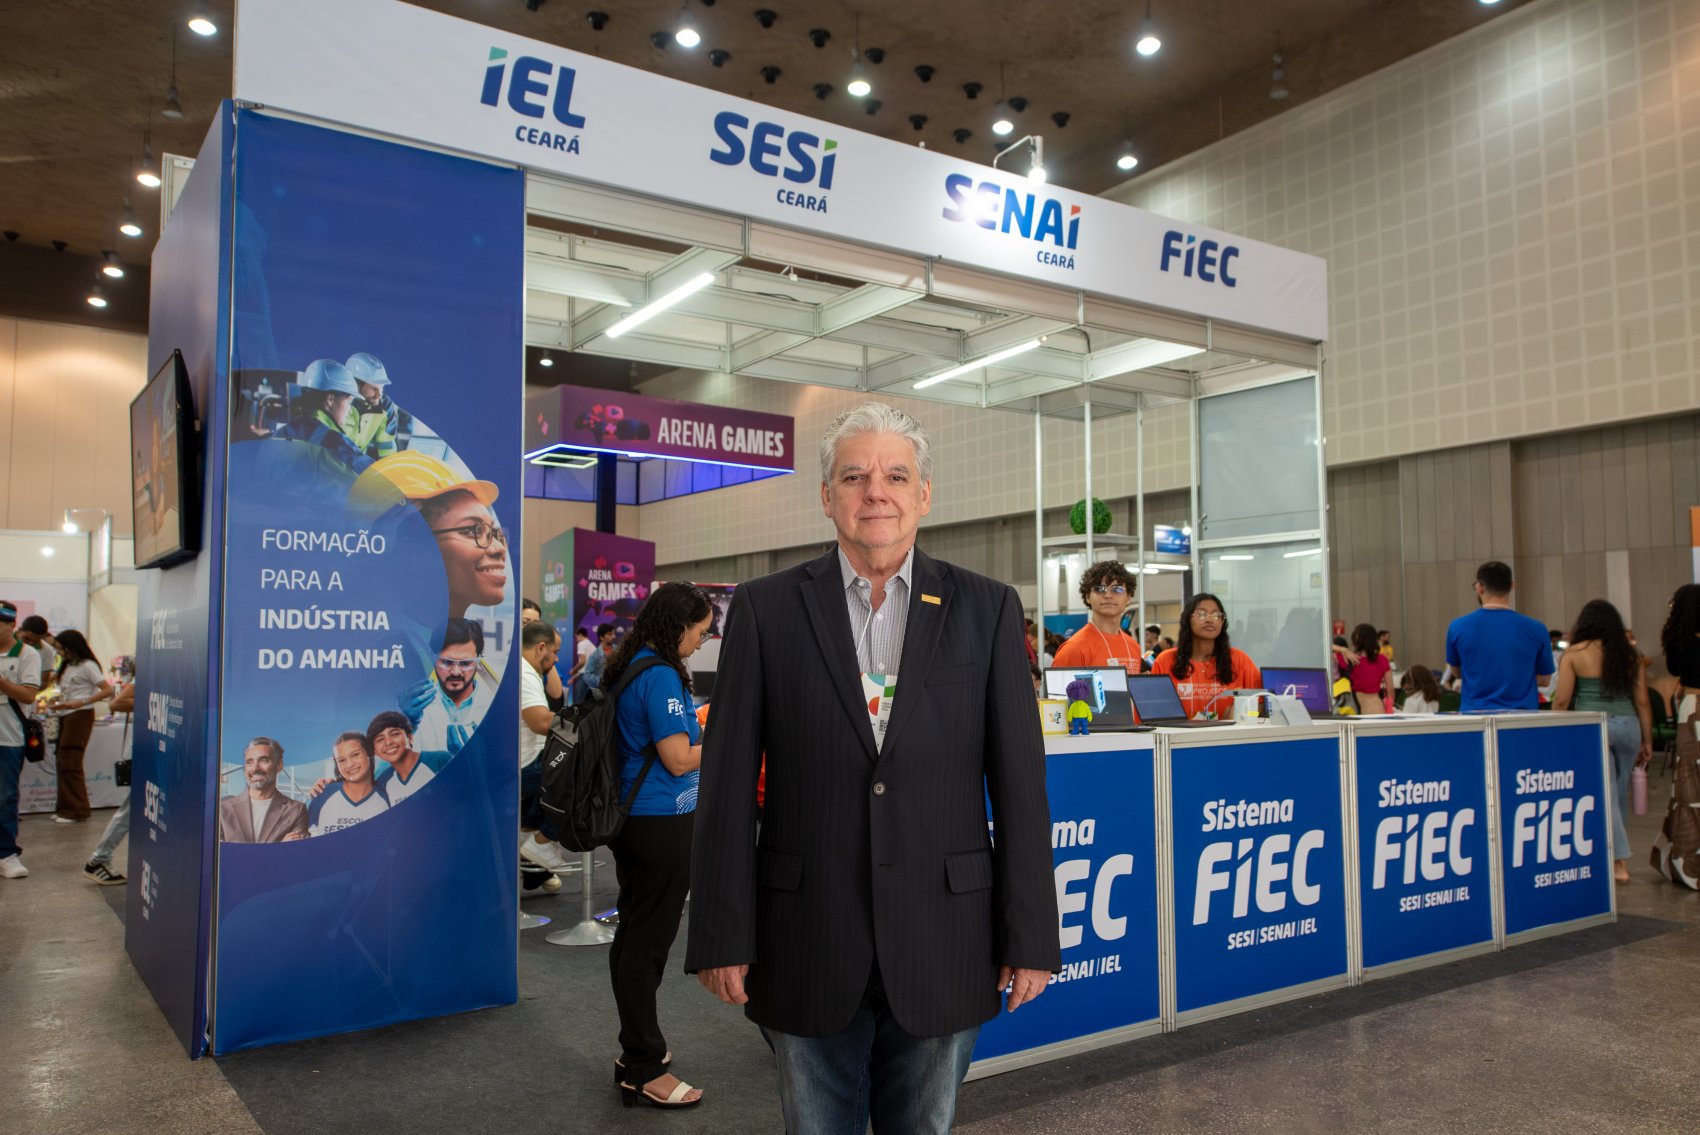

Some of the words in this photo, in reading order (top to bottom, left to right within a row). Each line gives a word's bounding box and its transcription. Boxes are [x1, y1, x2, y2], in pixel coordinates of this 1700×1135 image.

[515, 125, 580, 155] CEARÁ
[776, 188, 828, 213] CEARÁ
[1036, 250, 1075, 270] CEARÁ
[657, 417, 717, 449] ARENA
[721, 425, 785, 458] GAMES
[262, 529, 386, 557] FORMAÇÃO
[260, 568, 322, 591] PARA
[327, 571, 344, 591] A
[588, 568, 612, 581] ARENA
[587, 582, 636, 602] GAMES
[259, 604, 390, 631] INDÚSTRIA
[258, 648, 294, 670] DO
[299, 644, 405, 669] AMANHÃ
[1378, 778, 1450, 808] Sistema
[1514, 768, 1574, 795] Sistema
[1202, 799, 1294, 832] Sistema
